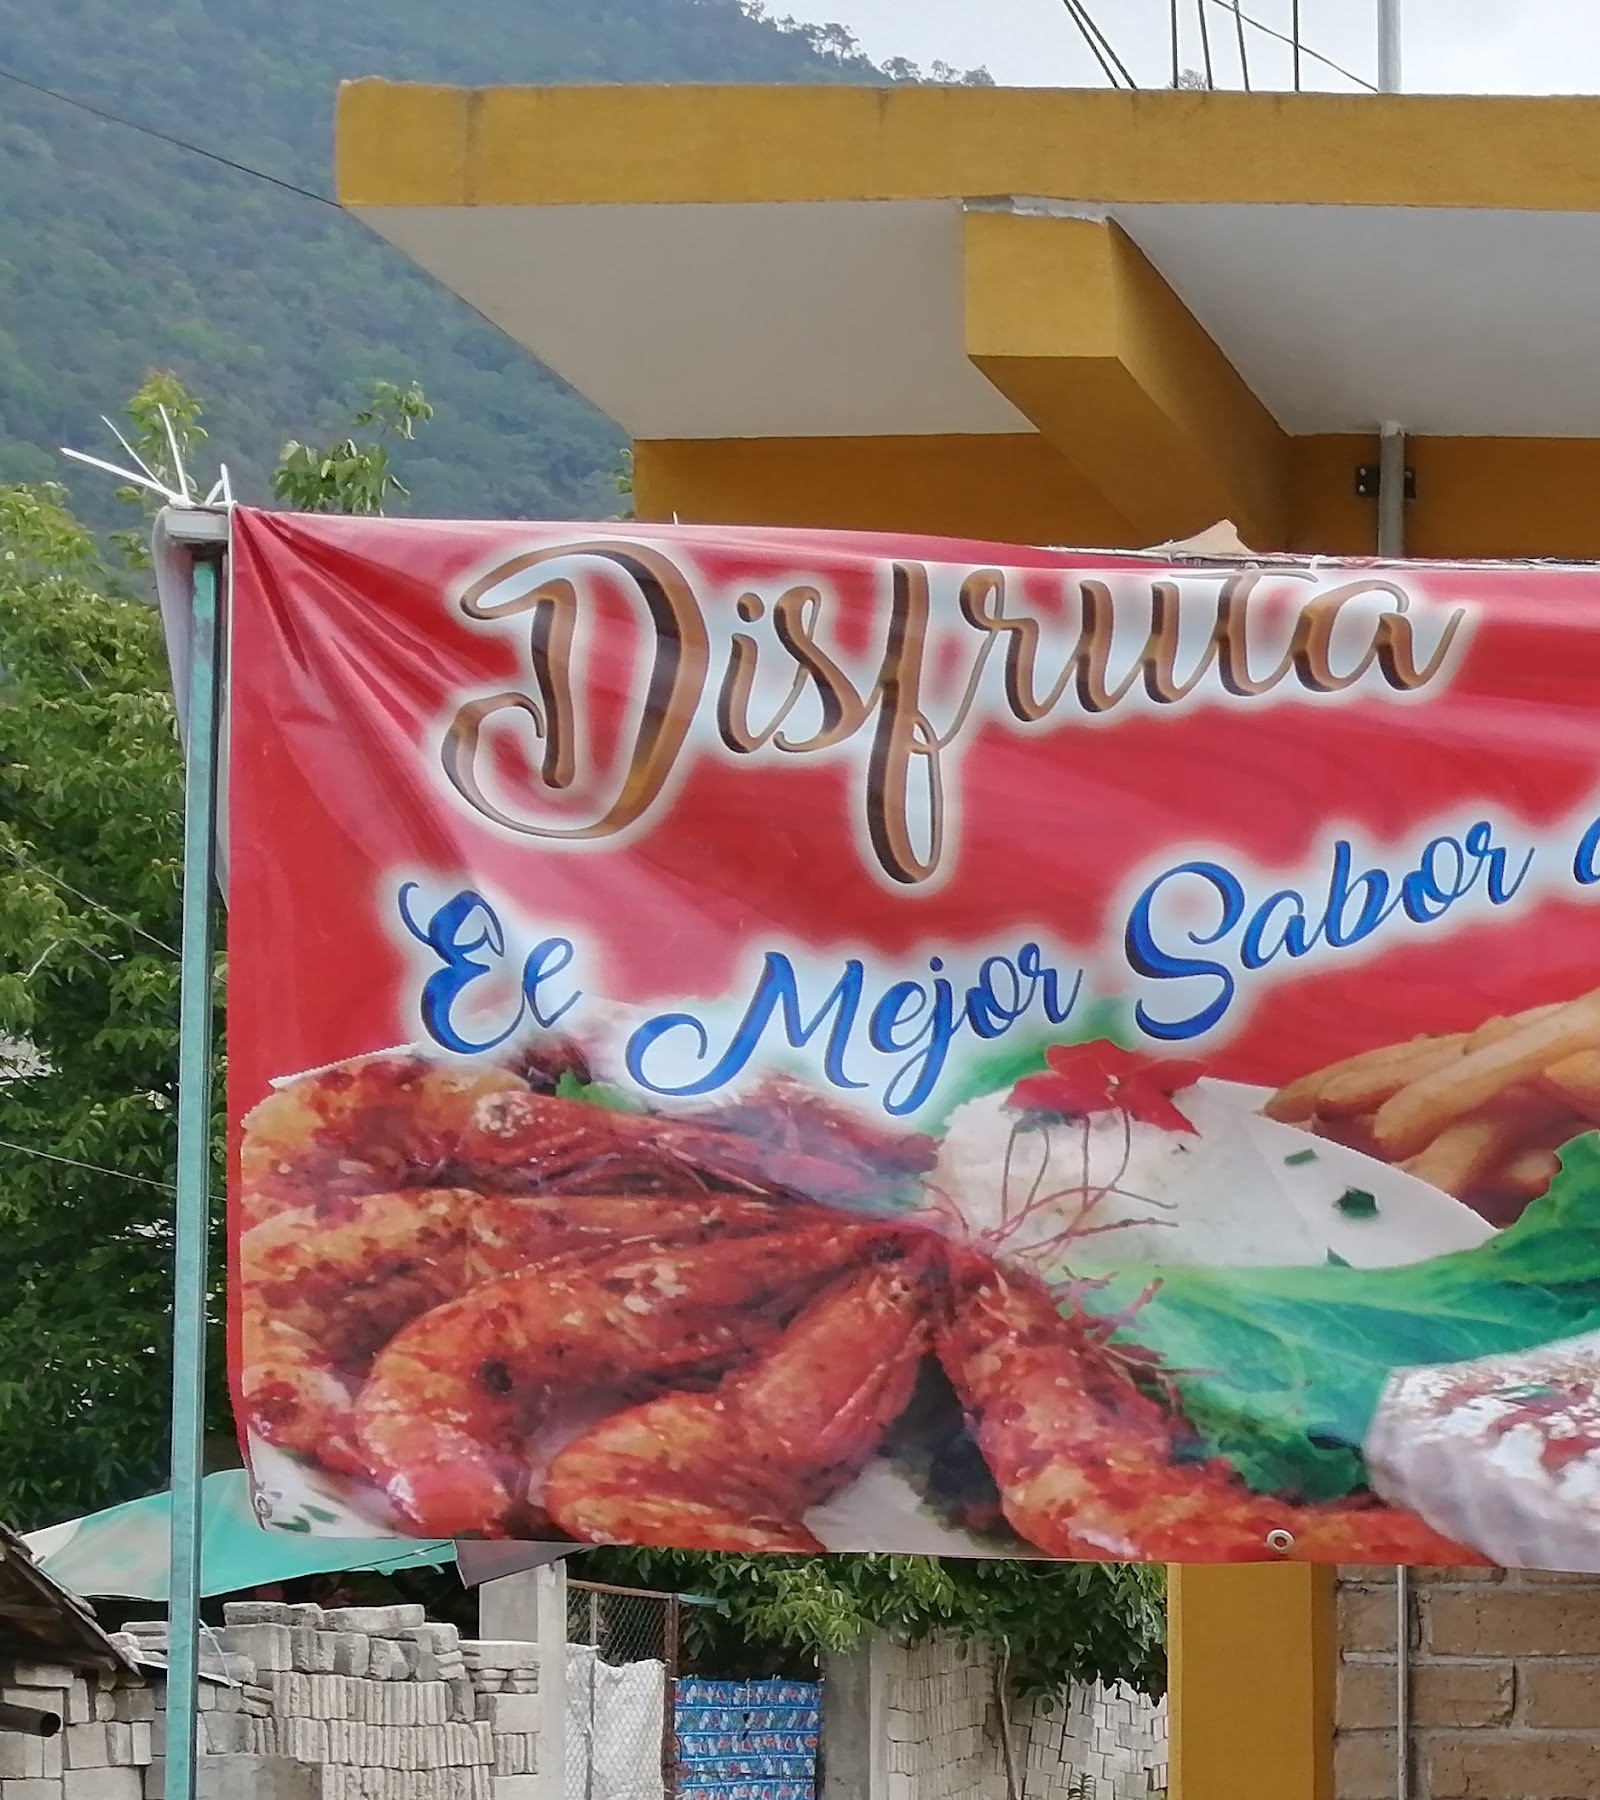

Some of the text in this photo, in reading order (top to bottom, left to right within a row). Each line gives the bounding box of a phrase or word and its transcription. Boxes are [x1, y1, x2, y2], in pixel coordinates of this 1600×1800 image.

[440, 540, 1467, 884] Disfruta
[624, 942, 1084, 1116] Mejor
[1123, 820, 1535, 1041] Sabor
